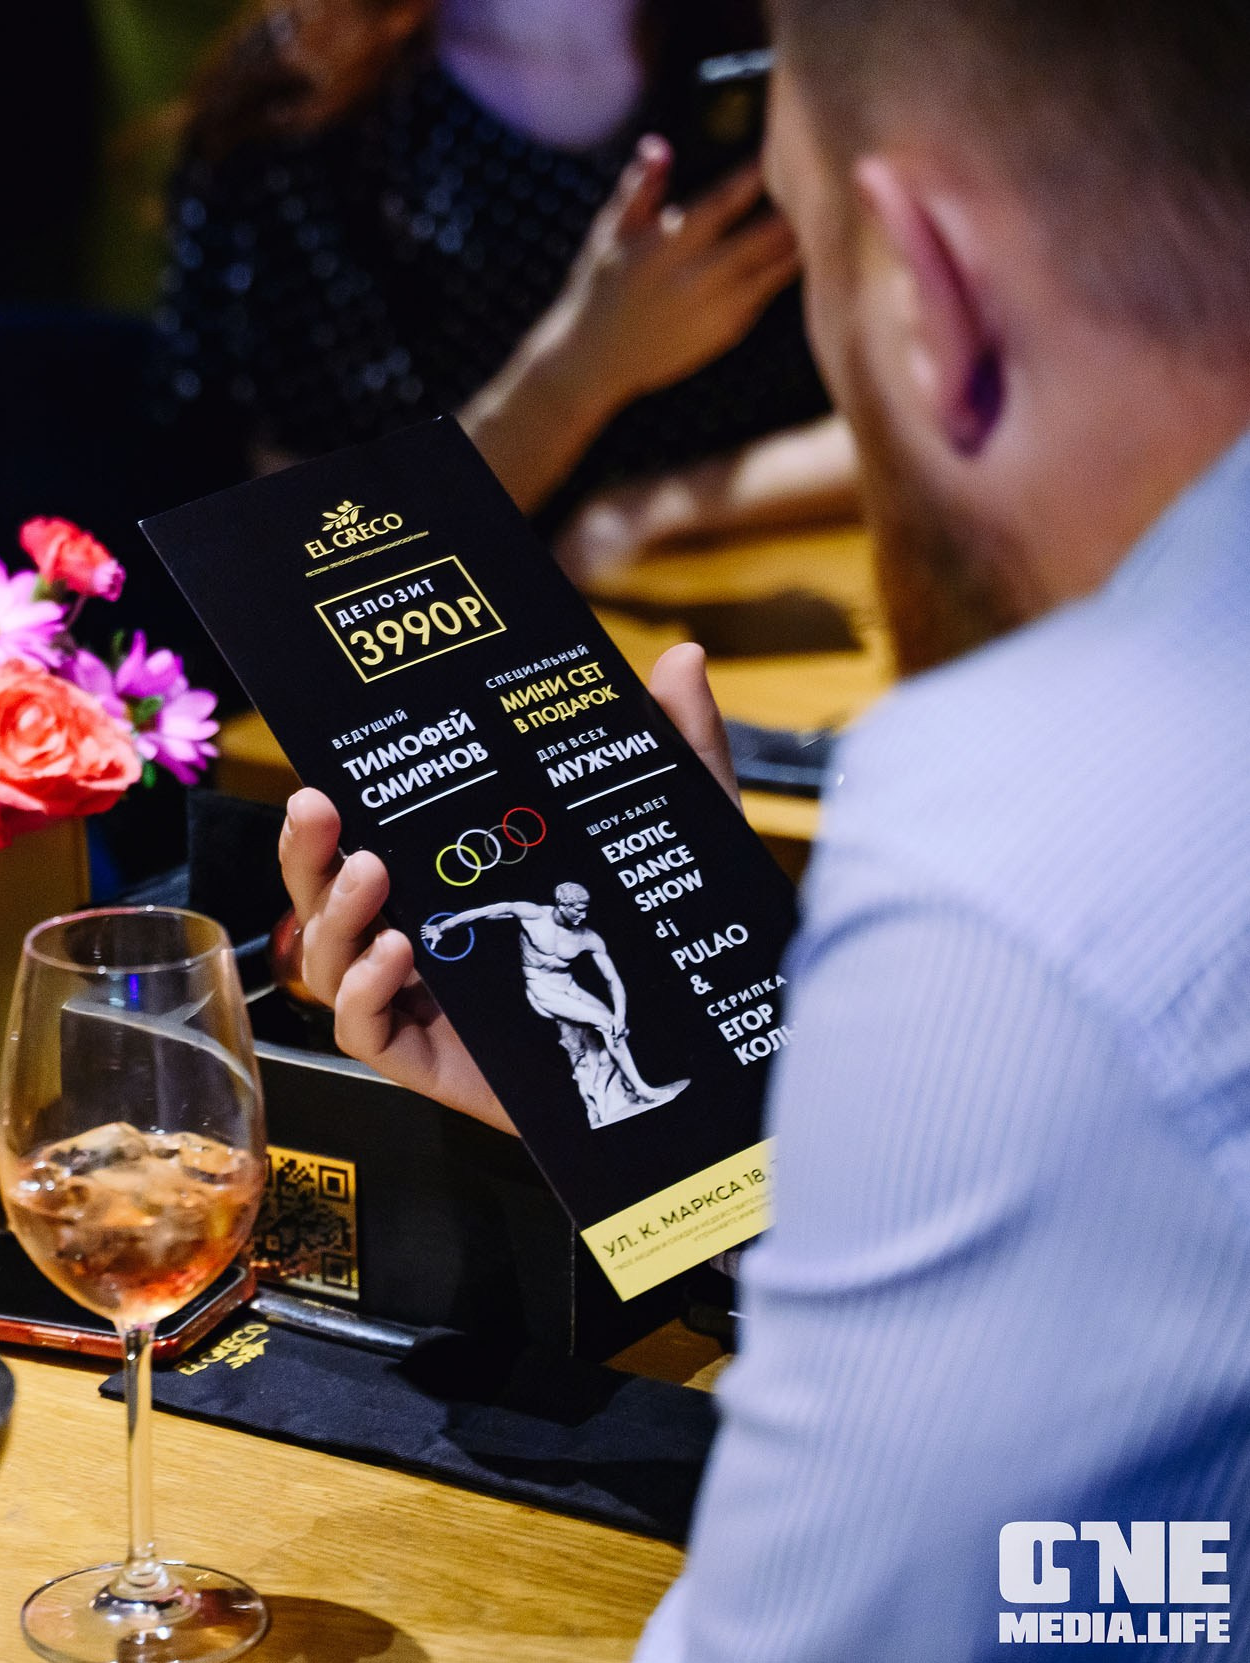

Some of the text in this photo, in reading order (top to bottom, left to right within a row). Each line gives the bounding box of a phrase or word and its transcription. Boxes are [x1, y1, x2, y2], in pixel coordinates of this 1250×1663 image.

[304, 539, 335, 560] EL
[332, 513, 404, 548] GRECO
[335, 578, 436, 628] ДЕПОЗИТ
[485, 644, 590, 689] СПЕЦИАЛЬНЫЙ
[500, 661, 605, 713] МИНИ СЕТ
[331, 709, 409, 750] ВЕДУЩИЙ
[513, 684, 620, 734] В ПОДАРОК
[342, 709, 476, 781] ТИМОФЕЙ
[536, 726, 608, 763] ДЛЯ ВСЕХ
[546, 731, 659, 788] МУЖЧИН
[361, 742, 489, 809] СМИРНОВ
[586, 795, 669, 836] ШОУ-БАЛЕТ
[601, 821, 677, 864] EXOTIC
[618, 844, 695, 889] DANCE
[634, 869, 703, 912] SHOW
[655, 918, 680, 938] di
[671, 924, 748, 971] PULAO
[690, 974, 714, 995] &
[706, 974, 787, 1017] СКРИПКА
[718, 1003, 773, 1042] ЕГОР
[602, 1234, 639, 1258] УЛ.
[638, 1223, 660, 1240] К.
[660, 1180, 744, 1230] МАРКСА
